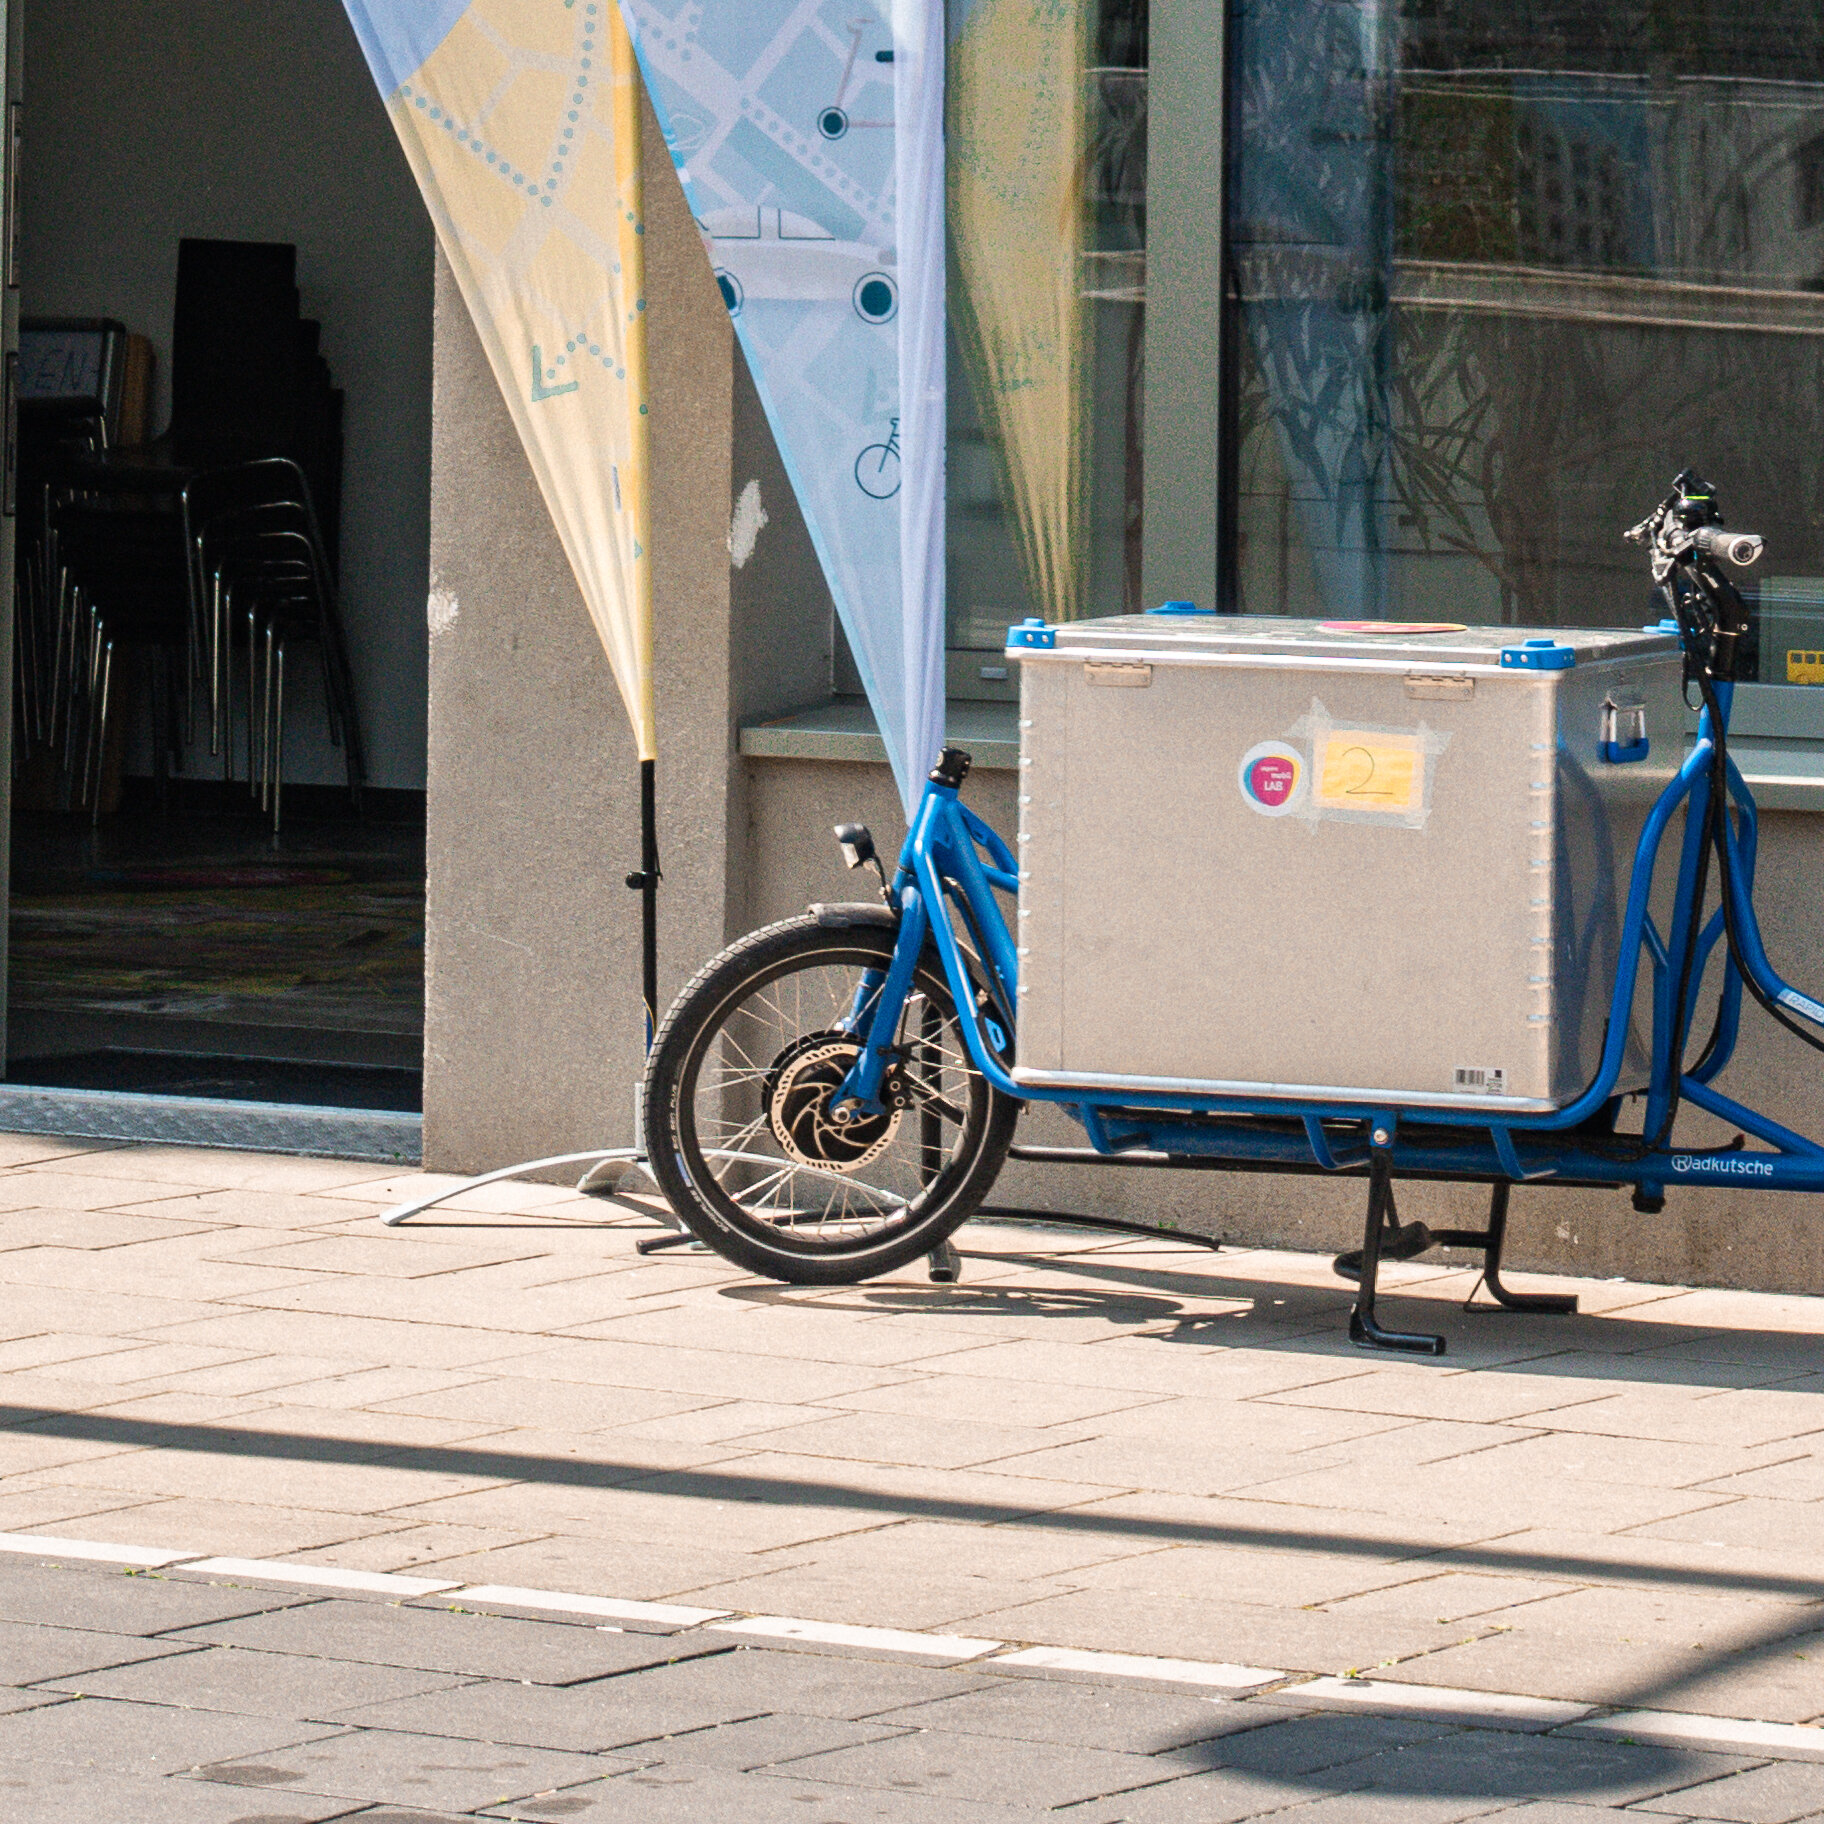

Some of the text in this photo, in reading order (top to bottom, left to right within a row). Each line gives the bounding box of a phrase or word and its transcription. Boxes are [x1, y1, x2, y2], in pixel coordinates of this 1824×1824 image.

[1342, 746, 1394, 795] 2
[1264, 780, 1284, 791] LAB
[1671, 1154, 1774, 1176] Radkutsche
